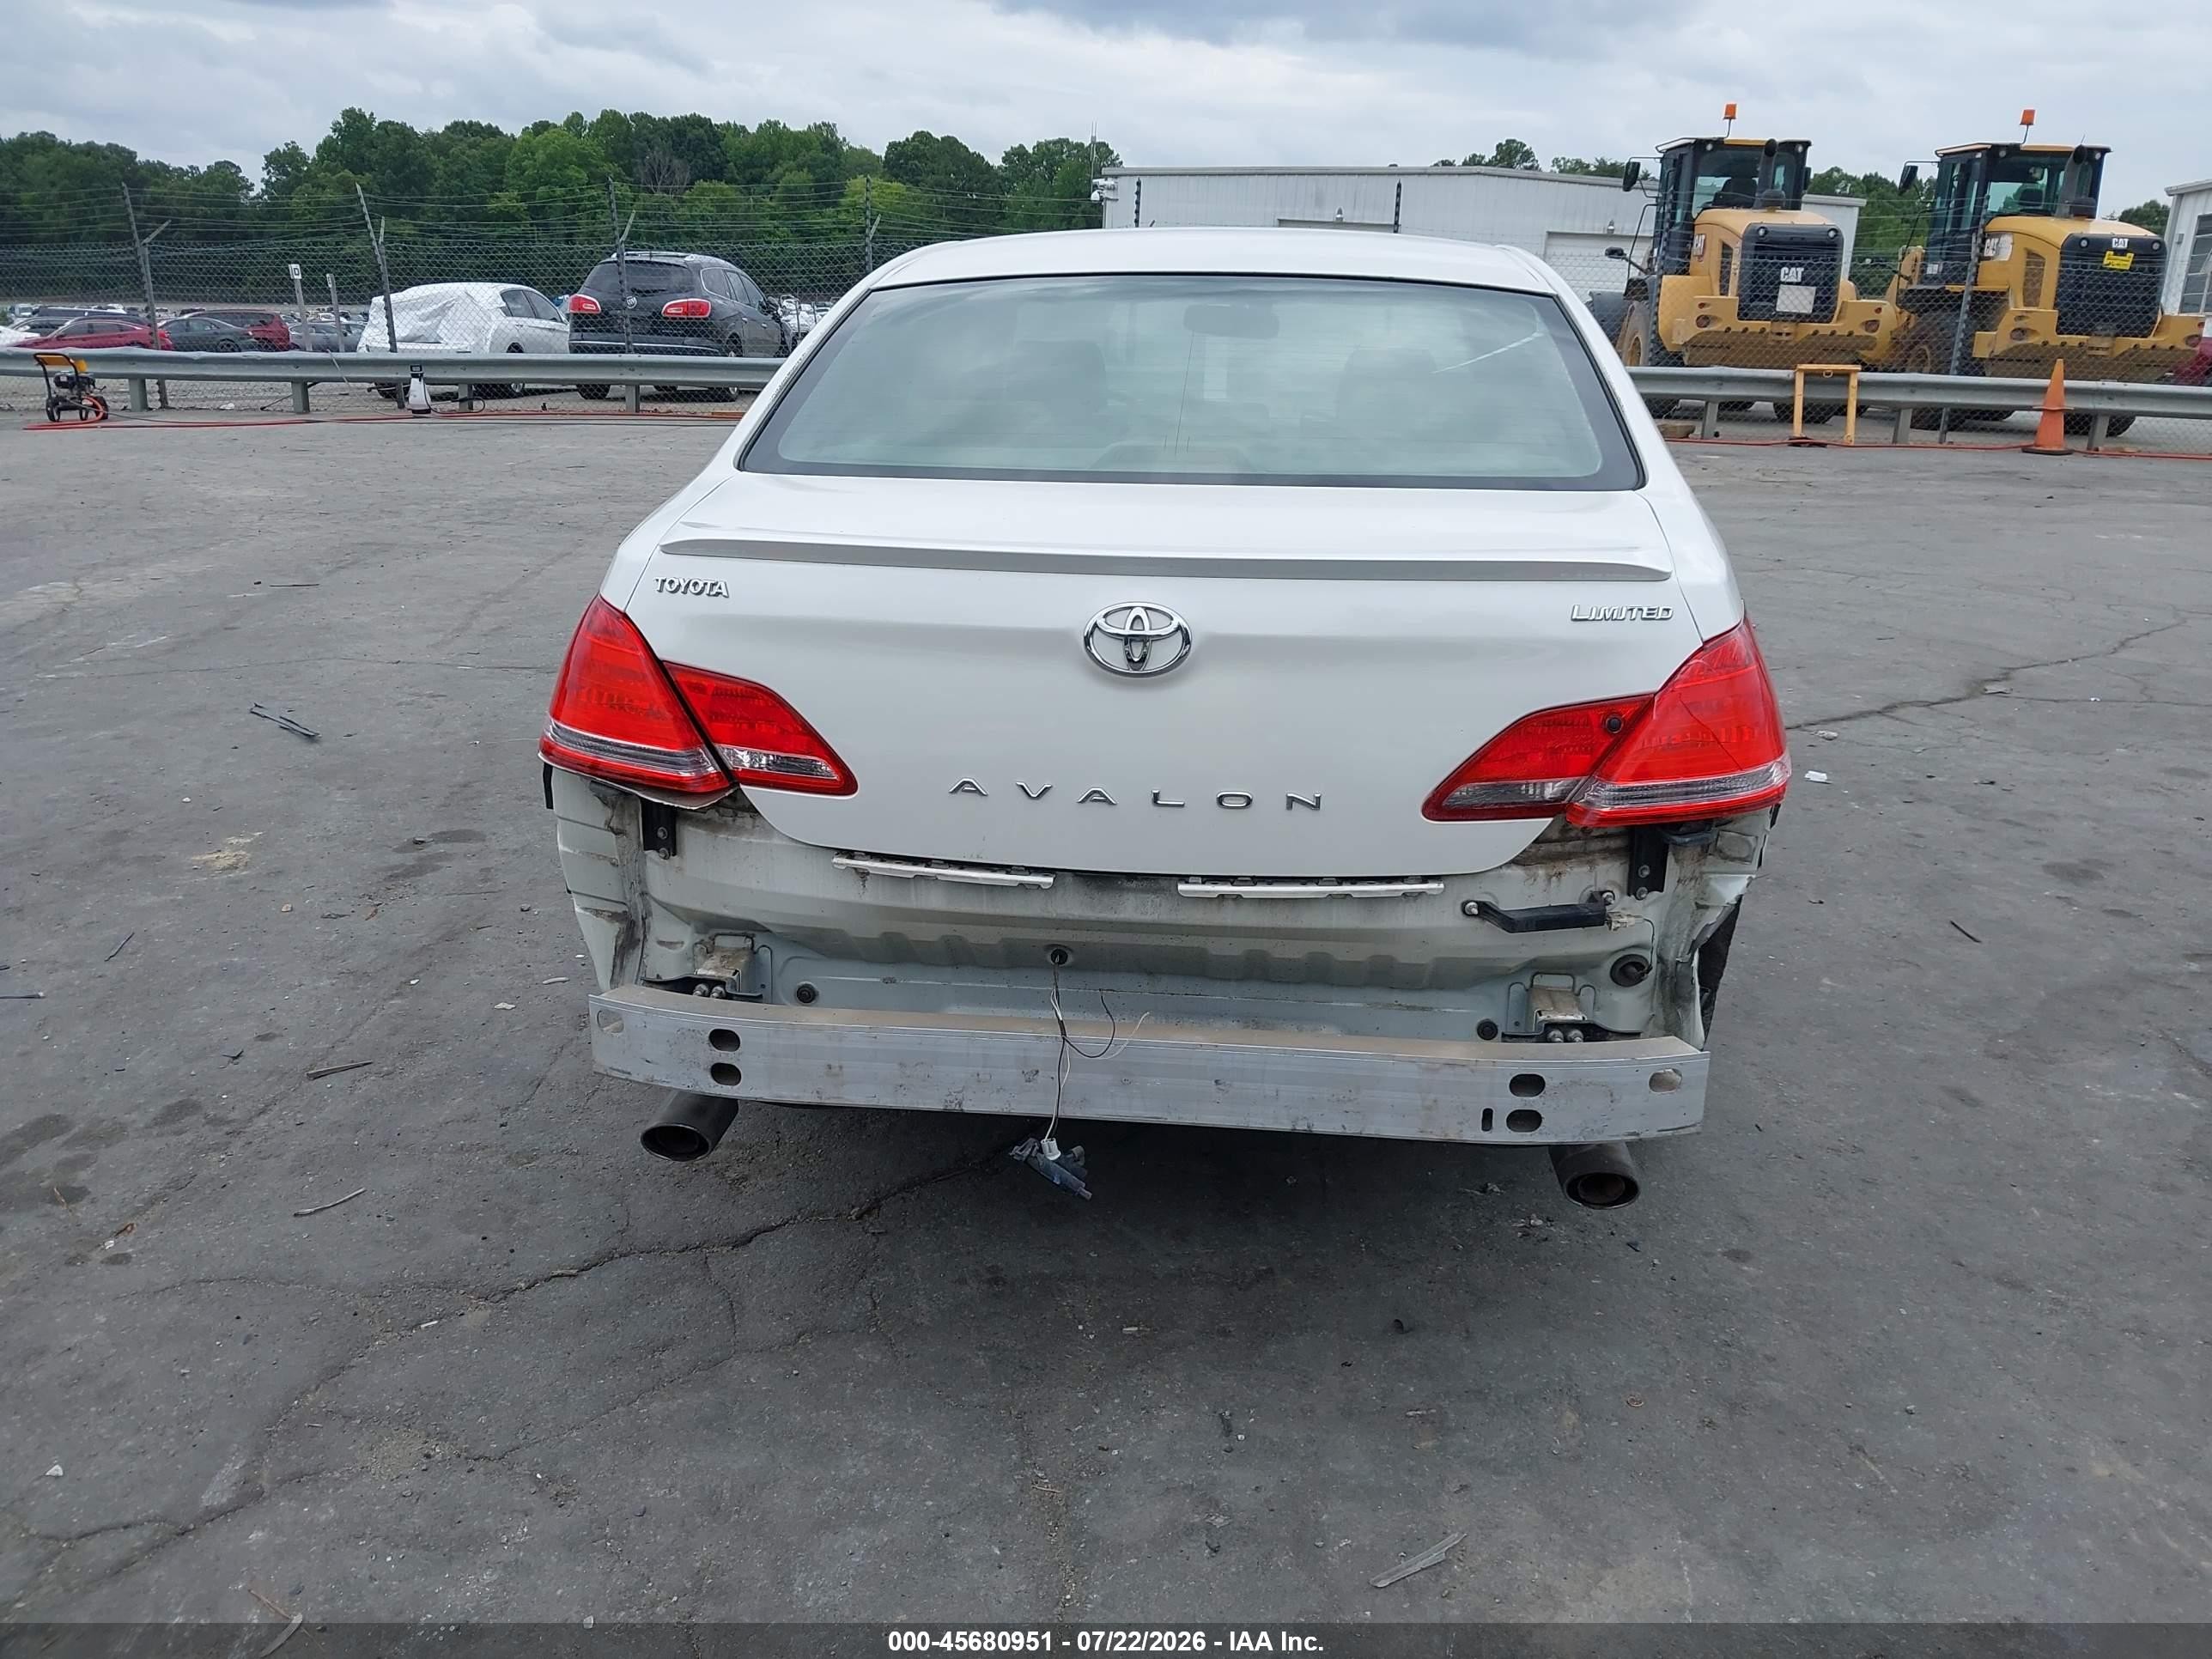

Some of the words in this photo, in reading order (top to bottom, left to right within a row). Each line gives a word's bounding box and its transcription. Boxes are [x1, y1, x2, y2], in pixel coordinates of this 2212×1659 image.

[2112, 238, 2129, 248] CAT
[1780, 267, 1804, 283] CAT
[654, 577, 729, 599] TOYOTA
[948, 777, 1322, 811] AVALON
